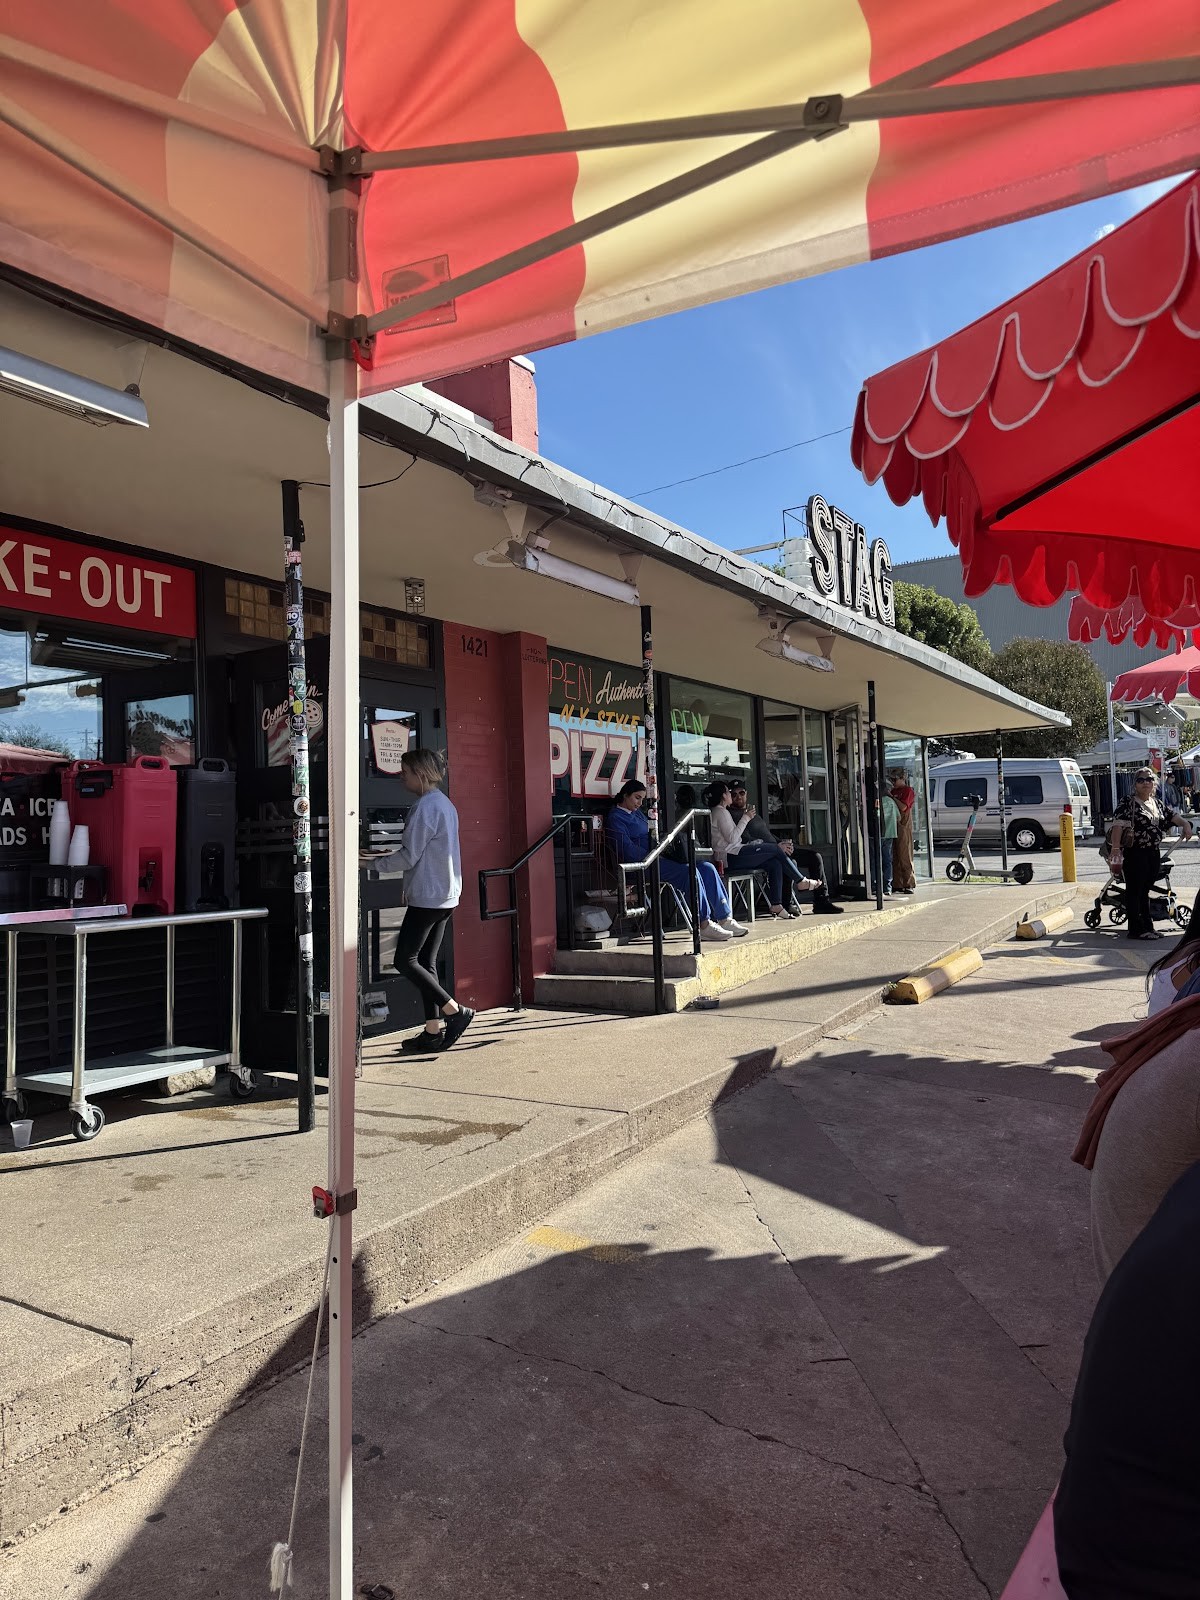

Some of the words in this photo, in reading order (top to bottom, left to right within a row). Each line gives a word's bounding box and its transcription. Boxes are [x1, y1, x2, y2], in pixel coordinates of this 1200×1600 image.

[807, 494, 896, 627] STAG
[461, 634, 488, 659] 1421
[546, 658, 592, 704] PEN
[595, 670, 645, 705] Authenti
[261, 699, 289, 730] Come
[596, 709, 641, 732] STYLE
[671, 708, 705, 737] PEN
